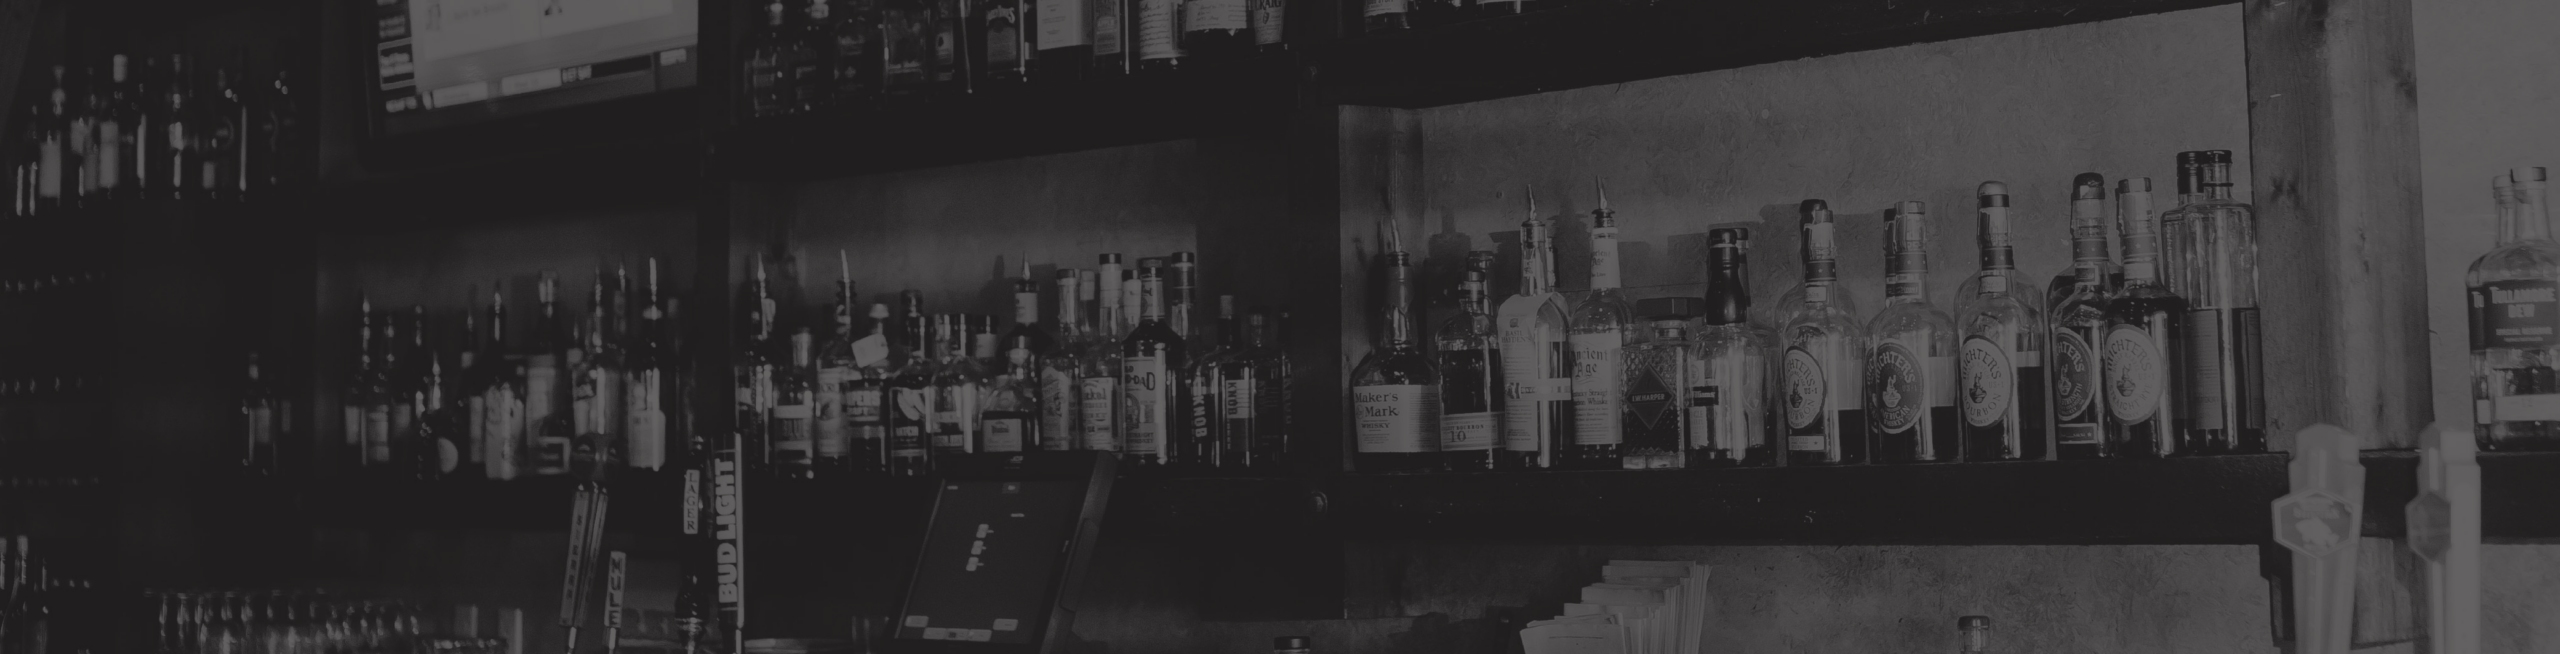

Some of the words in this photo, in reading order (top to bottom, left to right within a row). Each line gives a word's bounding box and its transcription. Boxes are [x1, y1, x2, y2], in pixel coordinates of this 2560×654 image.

[1574, 362, 1598, 378] Age
[2058, 341, 2086, 373] HTER'S
[1786, 358, 1816, 387] CHTER'S
[1227, 382, 1238, 416] KNOB
[1355, 392, 1399, 403] Maker's
[1364, 405, 1399, 418] Mark
[1641, 393, 1665, 402] HARPER
[1192, 395, 1208, 438] KNOB
[1450, 430, 1467, 443] 10
[686, 472, 698, 531] LAGER
[714, 458, 736, 540] LIGHT
[717, 542, 738, 603] BUD
